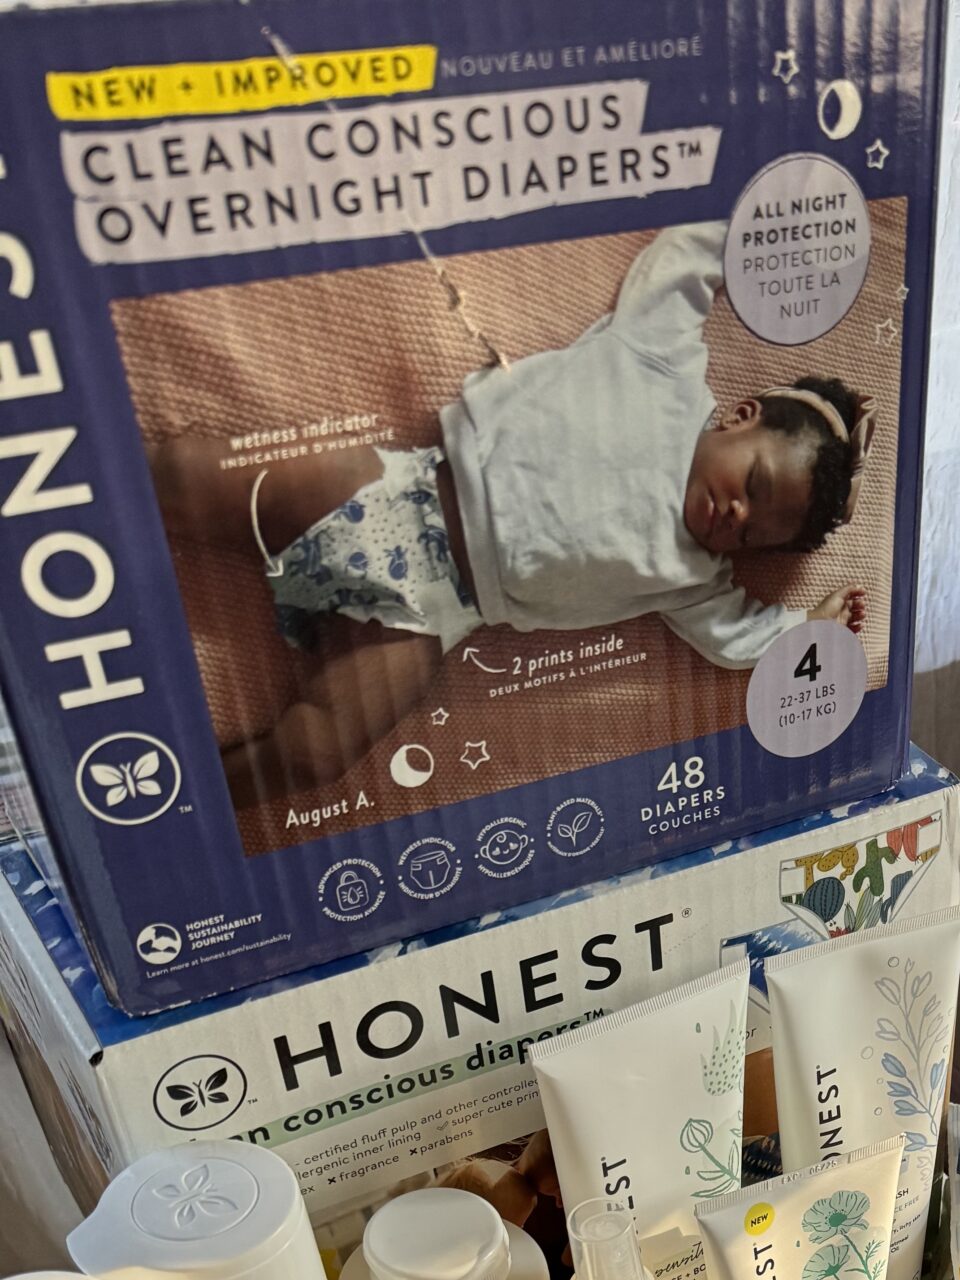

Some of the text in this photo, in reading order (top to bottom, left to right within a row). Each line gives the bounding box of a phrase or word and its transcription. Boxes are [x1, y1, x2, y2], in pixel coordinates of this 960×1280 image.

[441, 36, 702, 77] NOUVEAU ET AMÉLIORÉ
[71, 73, 158, 109] NEW
[216, 55, 413, 97] IMPROVED
[82, 95, 622, 184] CLEAN CONSCIOUS
[97, 171, 433, 244] OVERNIGHT
[752, 194, 847, 220] ALL NIGHT
[742, 219, 857, 248] PROTECTION
[743, 245, 855, 275] PROTECTION
[758, 271, 841, 297] TOUTE LA
[780, 299, 821, 319] NUIT
[230, 413, 379, 450] wetness indicator
[220, 430, 395, 469] INDICATEUR D'HUMIDITÉ
[512, 635, 624, 678] 2 prints inside
[793, 642, 822, 682] 4
[489, 684, 520, 698] DEUX
[524, 674, 566, 689] MOTIFS
[580, 652, 647, 675] L'INTÉRIEUR
[779, 701, 837, 727] (10-17 KG)
[780, 684, 836, 709] 22-37 LBS
[657, 756, 705, 793] 48
[285, 791, 375, 829] August A.
[641, 786, 725, 821] DIAPERS
[648, 807, 721, 835] COUCHES
[477, 817, 527, 842] HYPOALLERGENIC
[398, 837, 456, 866] WETNESS INDICATOR
[318, 858, 382, 894] ADVANCED PROTECTION
[399, 881, 434, 900] INDICATEUR
[186, 914, 225, 932] HONEST
[188, 913, 262, 941] SUSTAINABILITY
[322, 906, 363, 922] PROTECTION
[146, 932, 292, 979] Learn more at honest.com/sustainability
[191, 931, 236, 950] JOURNEY
[283, 1061, 455, 1132] conscious
[304, 1138, 358, 1165] certified
[362, 1127, 387, 1145] fluff
[390, 1118, 418, 1136] pulp
[421, 1110, 442, 1125] and
[446, 1098, 478, 1116] other
[353, 1089, 539, 1161] inner lining super cute prin
[339, 1128, 473, 1182] fragrance parabens
[750, 1213, 769, 1228] NEW
